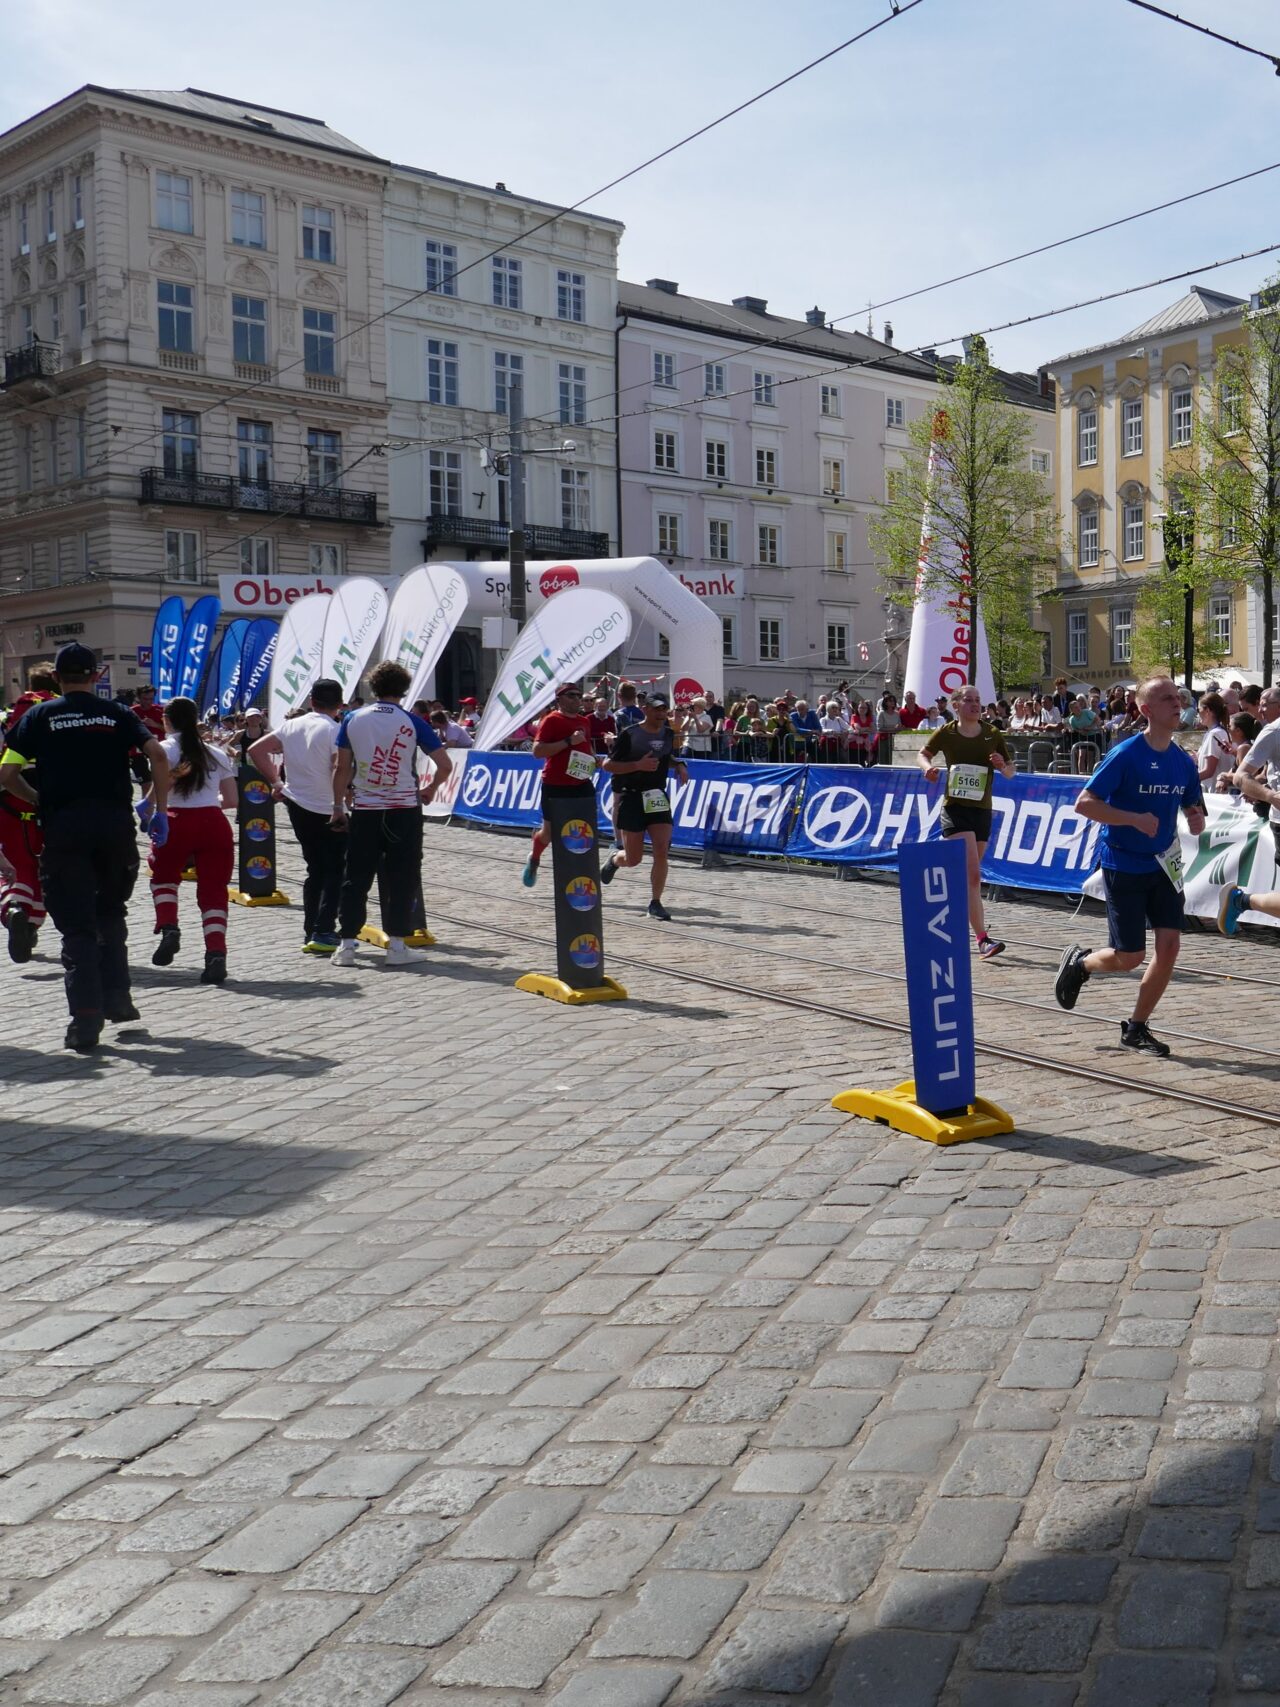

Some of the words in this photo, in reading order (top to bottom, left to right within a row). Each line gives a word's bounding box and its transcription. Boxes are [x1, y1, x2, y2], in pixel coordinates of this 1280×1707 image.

[233, 579, 333, 606] Oberb
[484, 577, 531, 599] Spt
[680, 573, 735, 596] bank
[352, 591, 381, 648] Nitrogen
[419, 577, 461, 644] Nitrogen
[162, 624, 178, 662] AG
[189, 623, 208, 664] AG
[557, 610, 623, 670] Nitrogen
[275, 654, 311, 705] LAT
[332, 642, 356, 686] AT
[1072, 669, 1131, 680] AYRHOFER
[497, 655, 555, 717] LAT
[49, 715, 117, 731] feuerwehr
[367, 745, 389, 785] LINZ
[958, 776, 980, 787] 5166
[666, 777, 796, 835] YUNDAI
[952, 789, 969, 797] LAT
[1139, 784, 1169, 794] LINZ
[1171, 785, 1186, 795] AG
[870, 793, 1101, 870] HYNDAI
[923, 866, 952, 943] AG
[930, 956, 960, 1081] LINZ
